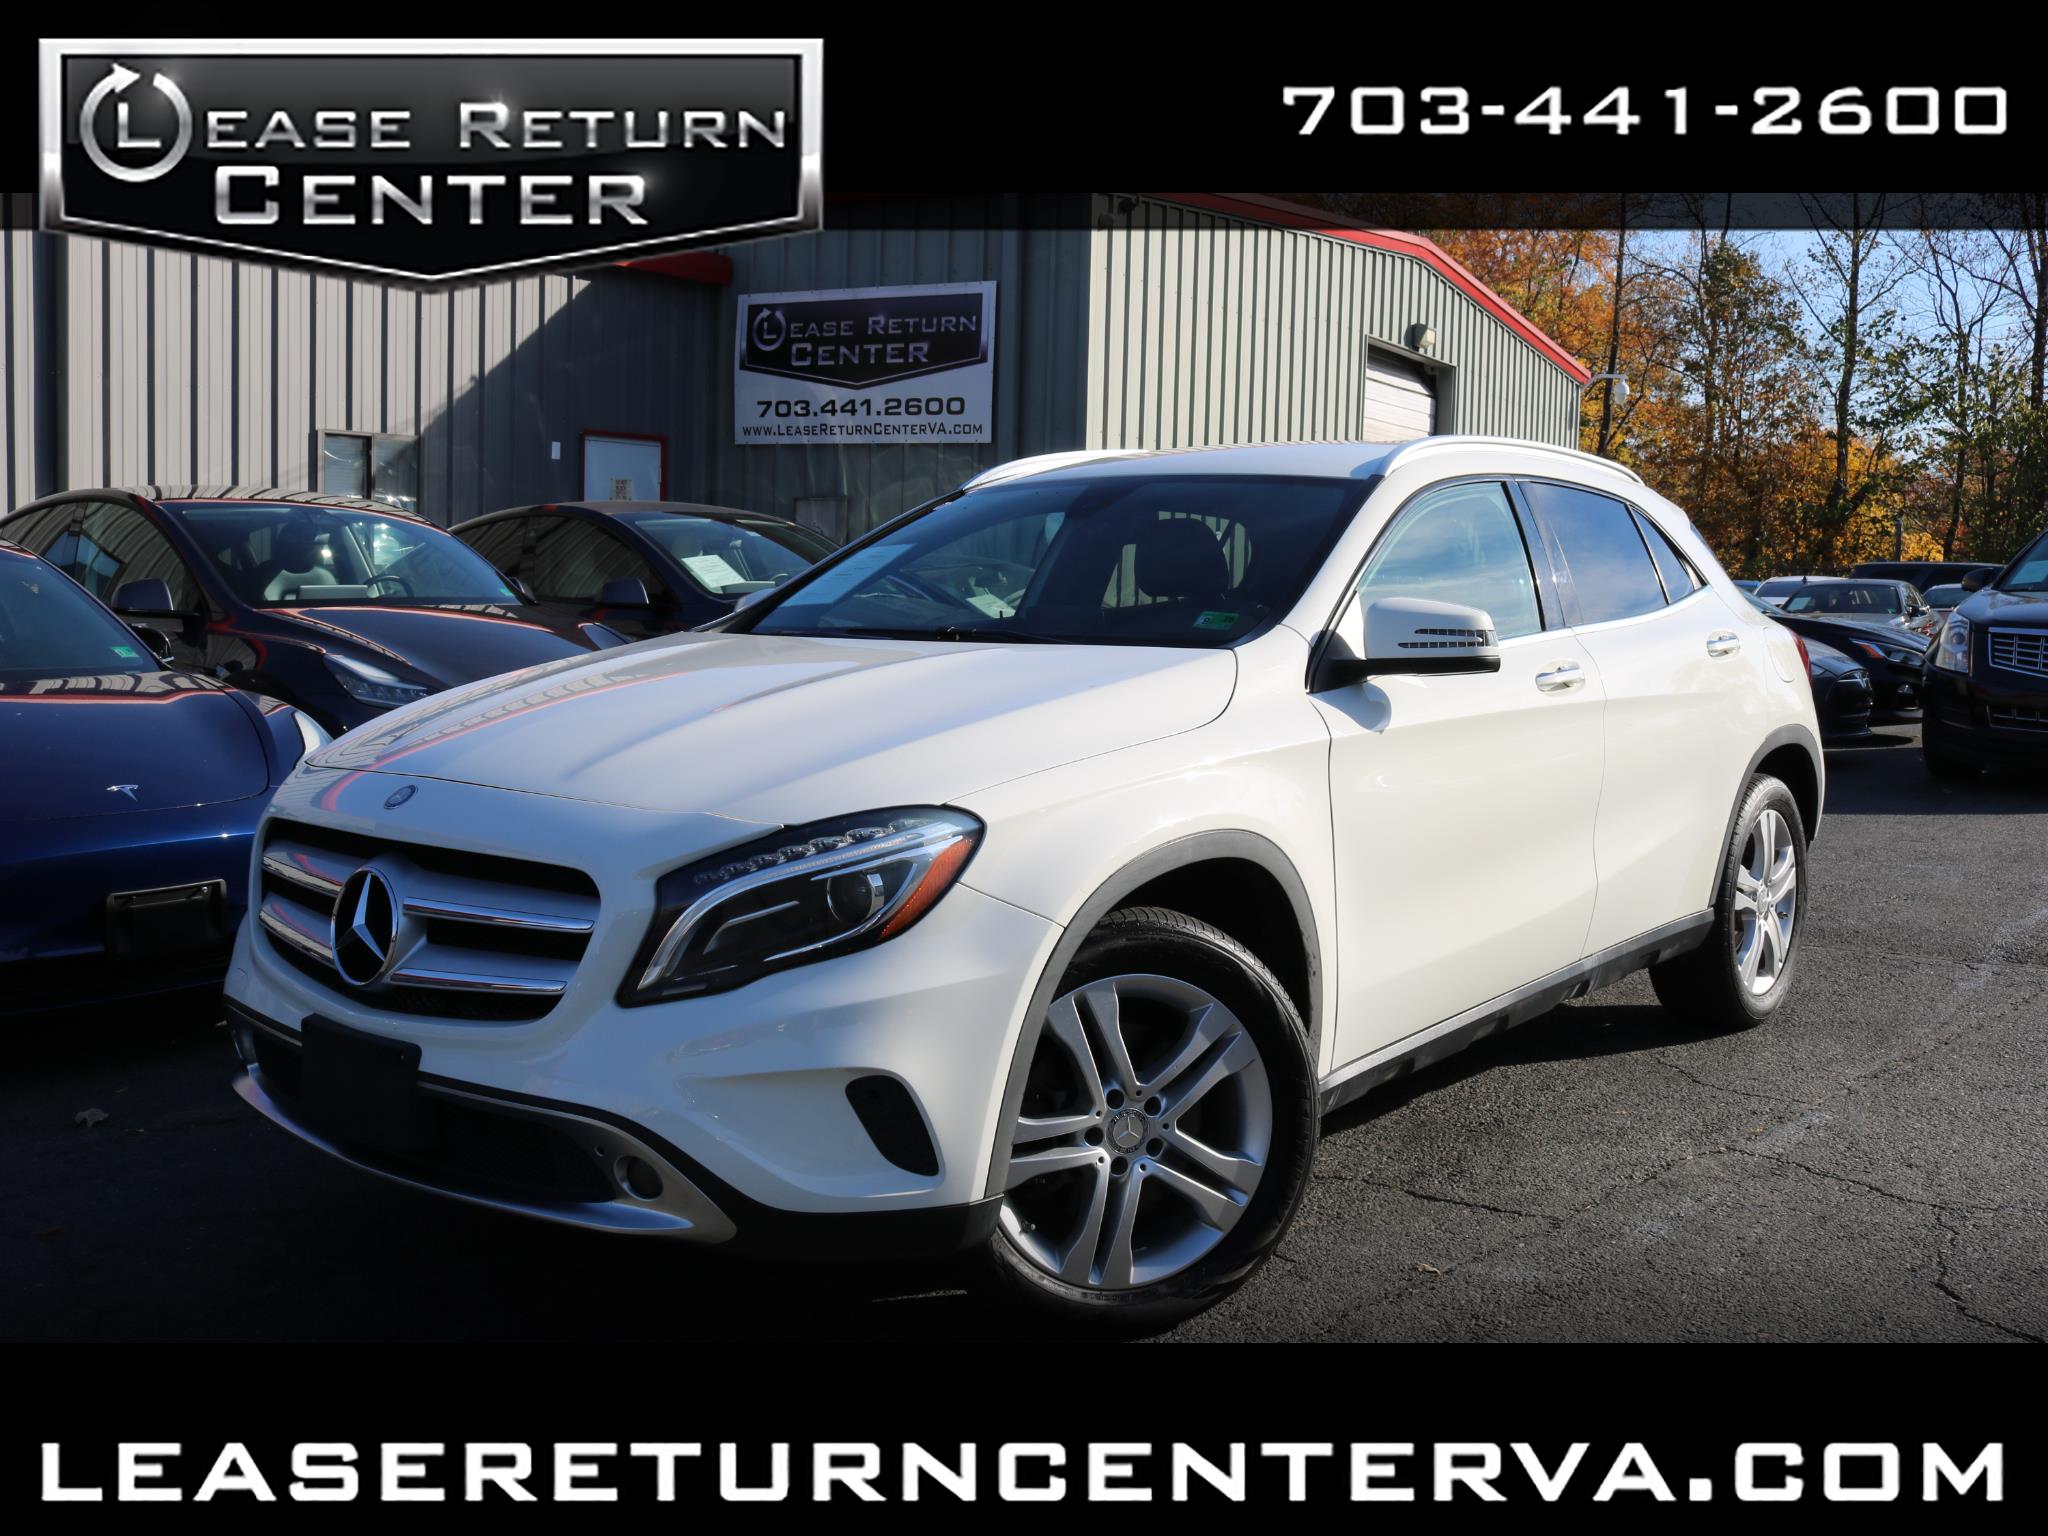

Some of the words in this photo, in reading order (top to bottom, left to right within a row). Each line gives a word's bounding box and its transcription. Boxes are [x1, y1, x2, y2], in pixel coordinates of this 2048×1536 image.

[763, 320, 854, 339] LEASE
[867, 315, 977, 335] RETURN
[791, 341, 929, 366] CENTER
[757, 397, 965, 418] 703.441.2600
[742, 422, 983, 436] WWW.LEASERETURNCENTERVA.COM
